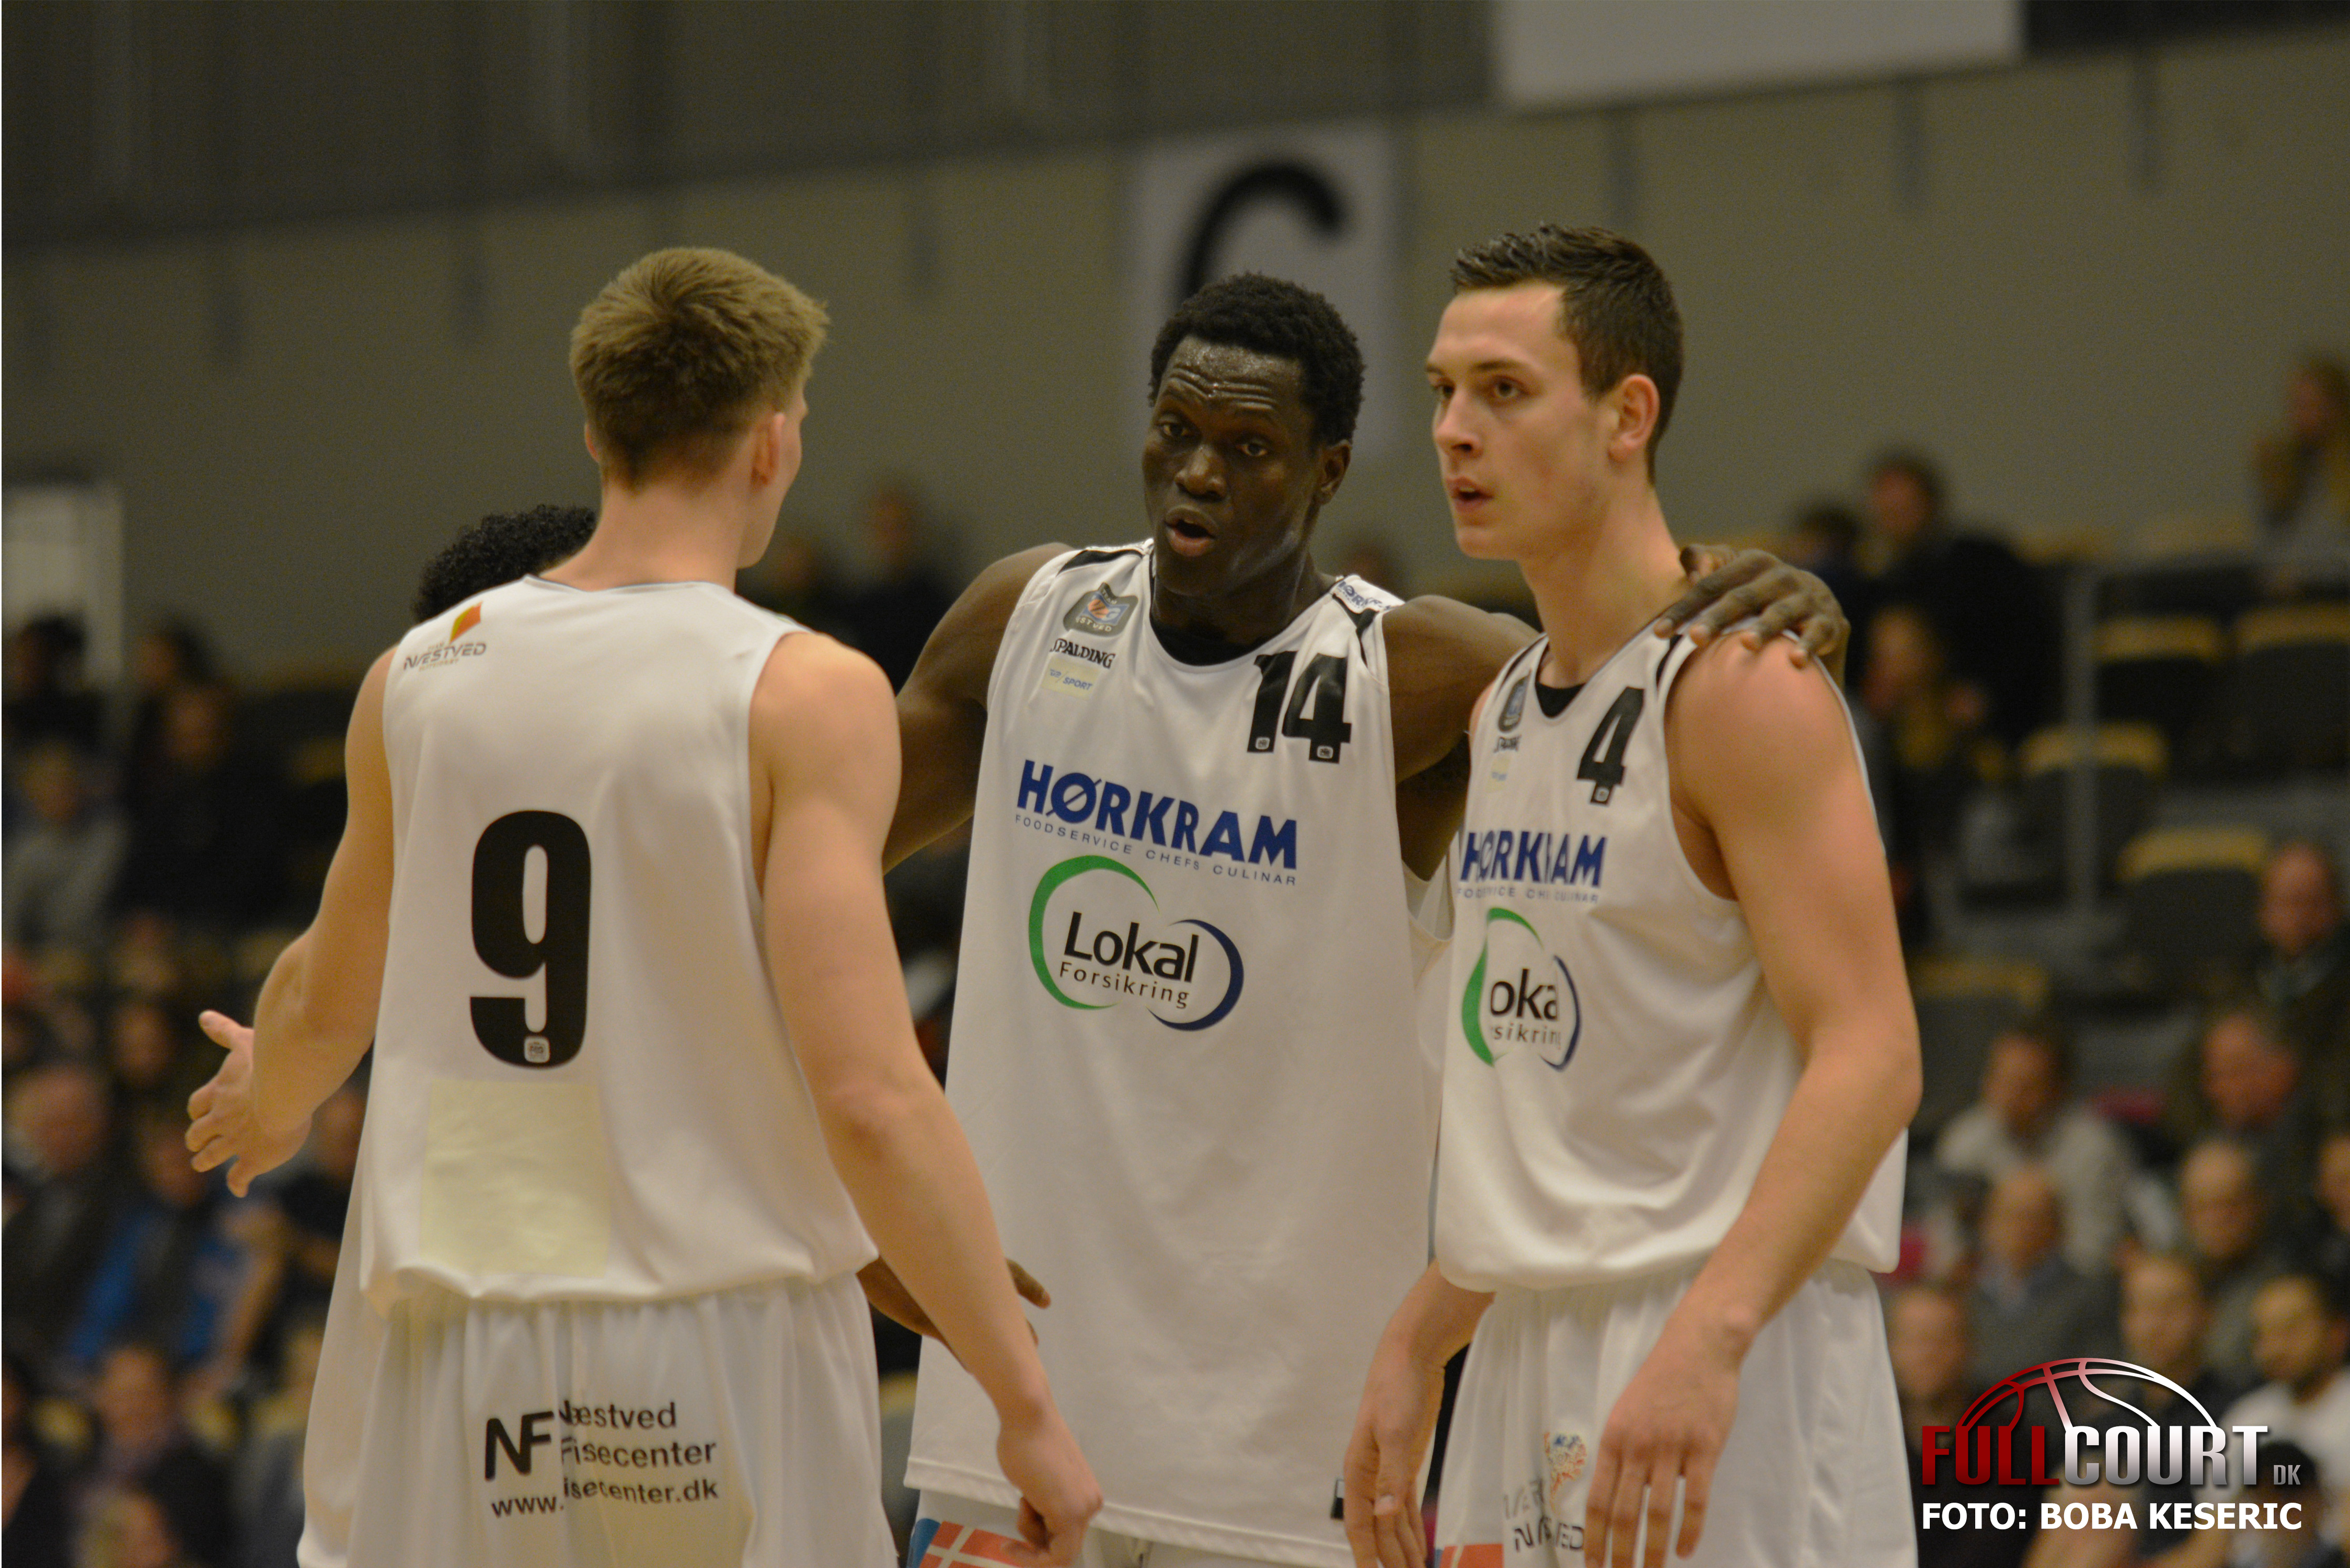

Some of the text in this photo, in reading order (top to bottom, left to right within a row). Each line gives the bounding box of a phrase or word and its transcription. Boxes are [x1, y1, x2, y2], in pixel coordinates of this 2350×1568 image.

[403, 642, 487, 671] NÆSTVED
[1049, 638, 1116, 669] SPALDING
[1063, 676, 1093, 690] SPORT
[1247, 650, 1352, 764] 14
[1576, 686, 1645, 806] 4
[1015, 814, 1297, 886] FOODSERVICE CHEFS CULINAR
[1017, 759, 1298, 870] HØRKRAM
[469, 810, 592, 1070] 9
[1064, 911, 1199, 983] Lokal
[1059, 961, 1190, 1010] Forsikring
[484, 1410, 555, 1481] NF
